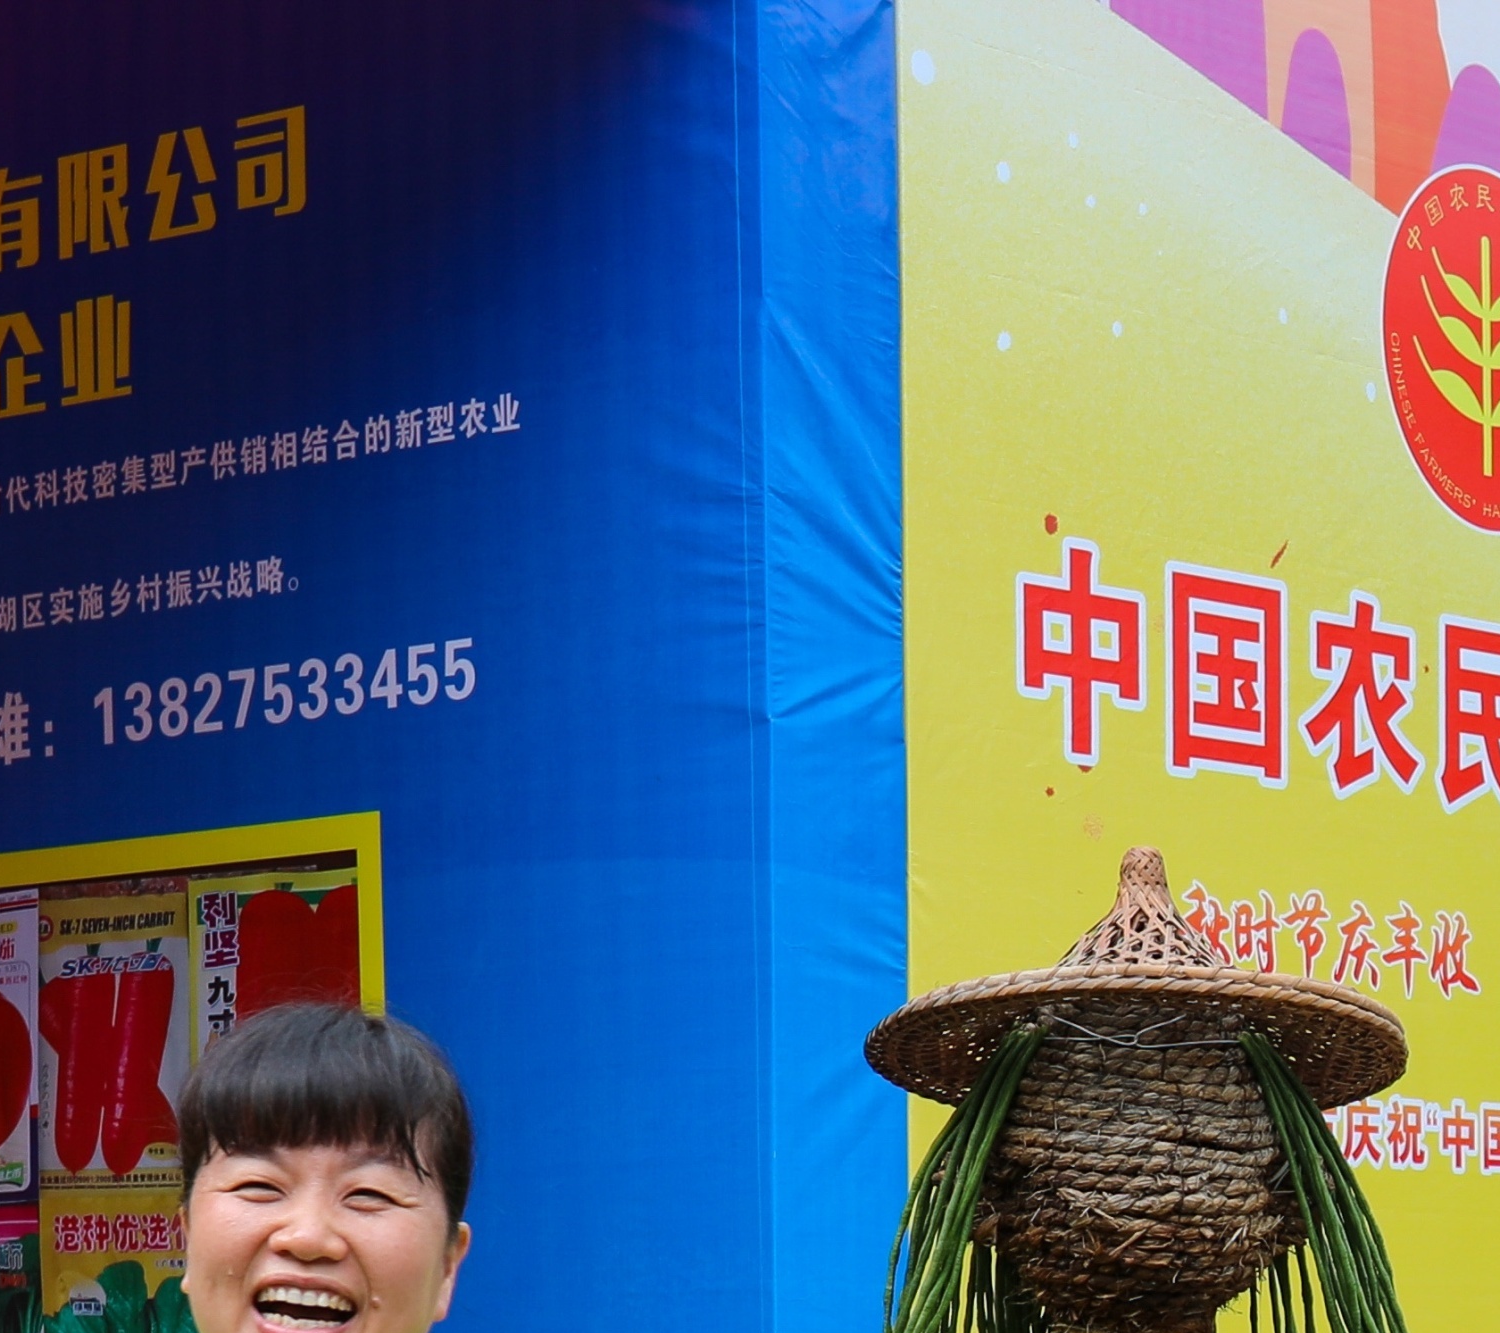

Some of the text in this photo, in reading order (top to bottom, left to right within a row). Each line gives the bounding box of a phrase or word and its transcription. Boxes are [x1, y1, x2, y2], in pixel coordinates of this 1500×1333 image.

[1389, 332, 1416, 428] CHINESE
[82, 914, 136, 934] SEVEN-INCH
[137, 911, 176, 928] CARROT
[202, 892, 239, 969] 利坚
